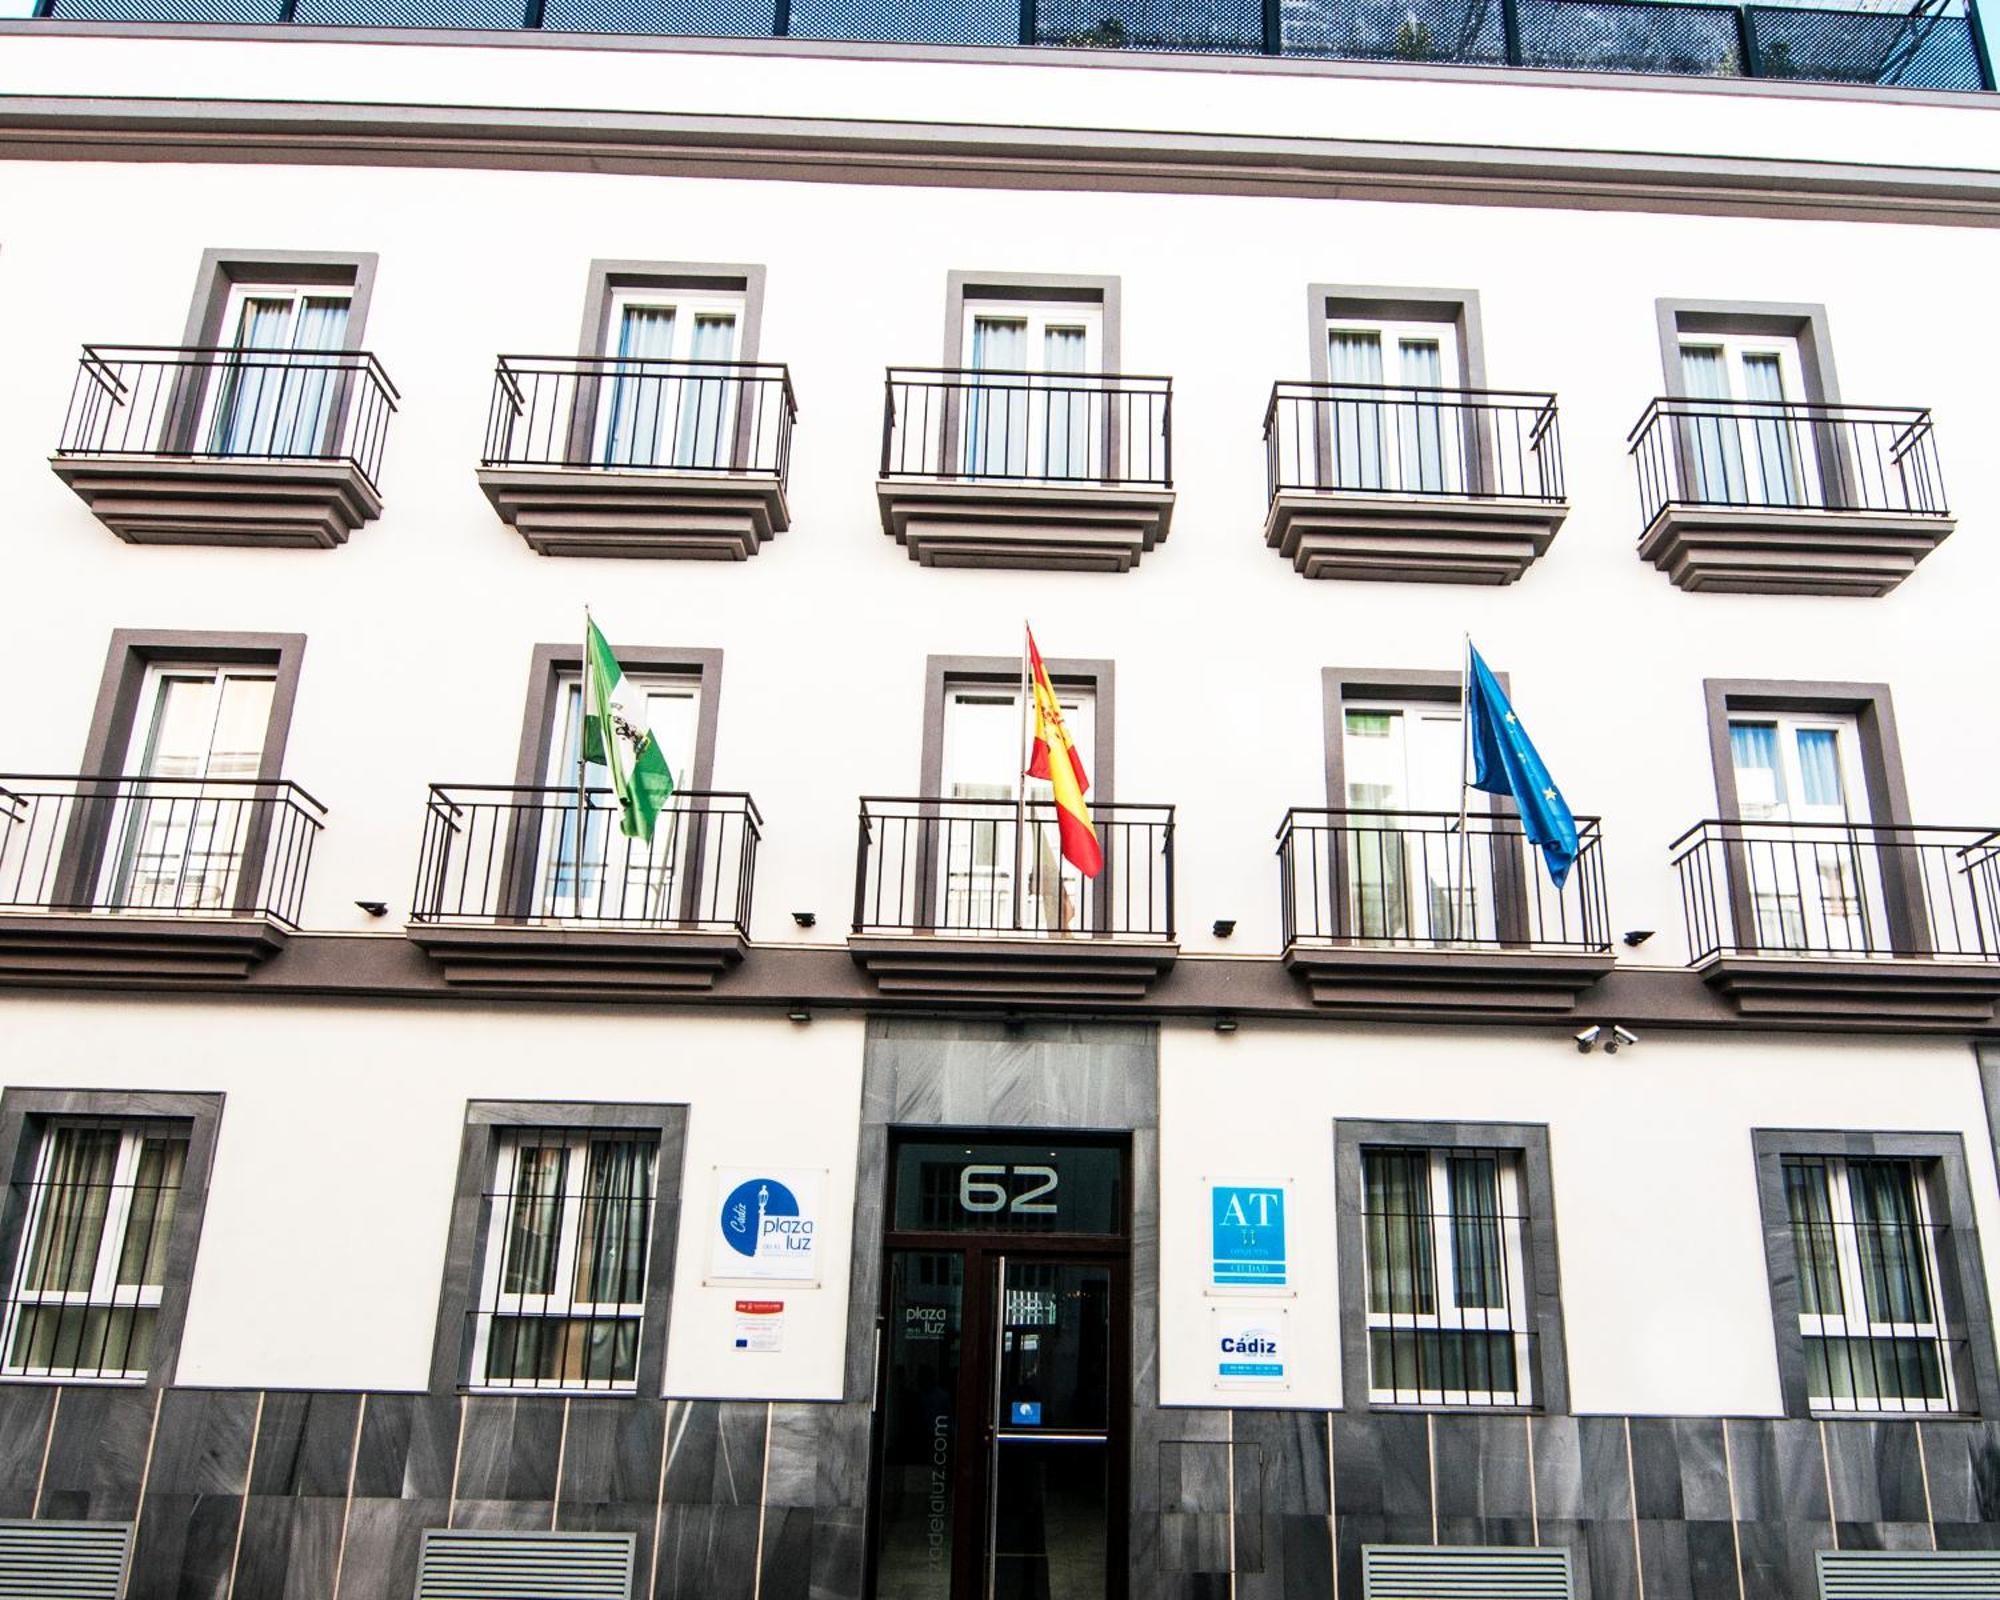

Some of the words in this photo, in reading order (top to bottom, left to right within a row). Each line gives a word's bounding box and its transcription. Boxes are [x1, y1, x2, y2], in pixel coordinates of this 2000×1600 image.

[959, 1164, 1059, 1213] 62
[1218, 1192, 1279, 1227] AT
[763, 1217, 814, 1237] plaza
[786, 1234, 812, 1251] luz
[906, 1306, 947, 1323] plaza
[924, 1320, 945, 1334] luz
[1221, 1337, 1277, 1354] Cádiz
